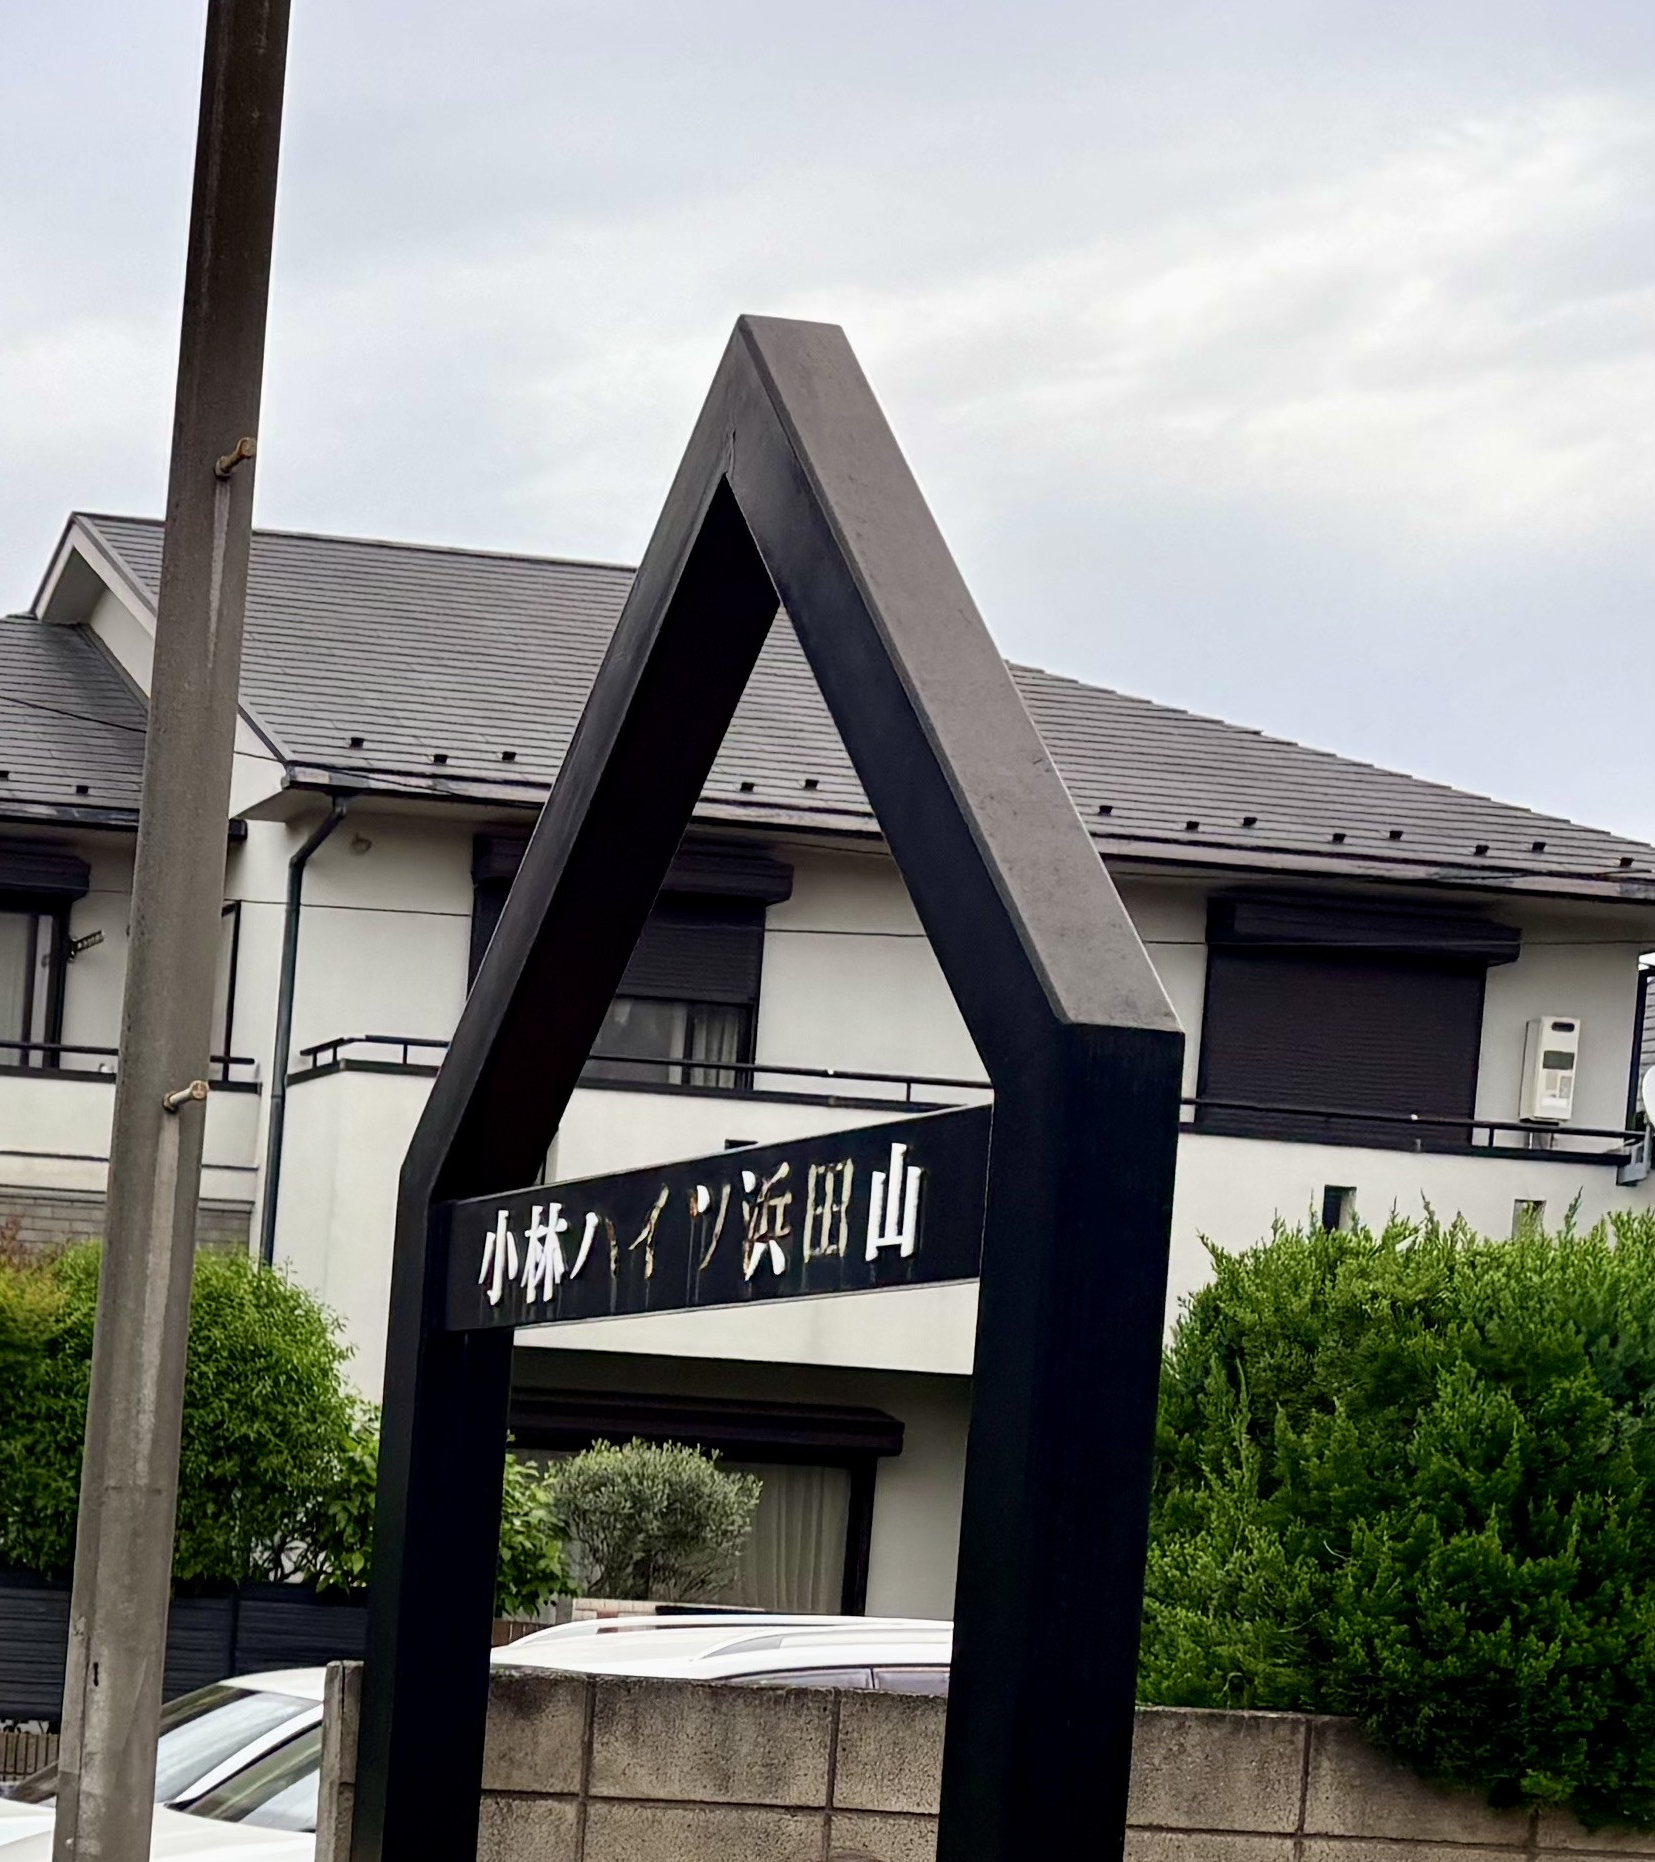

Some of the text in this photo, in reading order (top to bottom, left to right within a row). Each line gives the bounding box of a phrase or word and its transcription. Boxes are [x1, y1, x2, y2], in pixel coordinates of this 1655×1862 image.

[477, 1142, 923, 1305] 小林ハイツ浜田山
